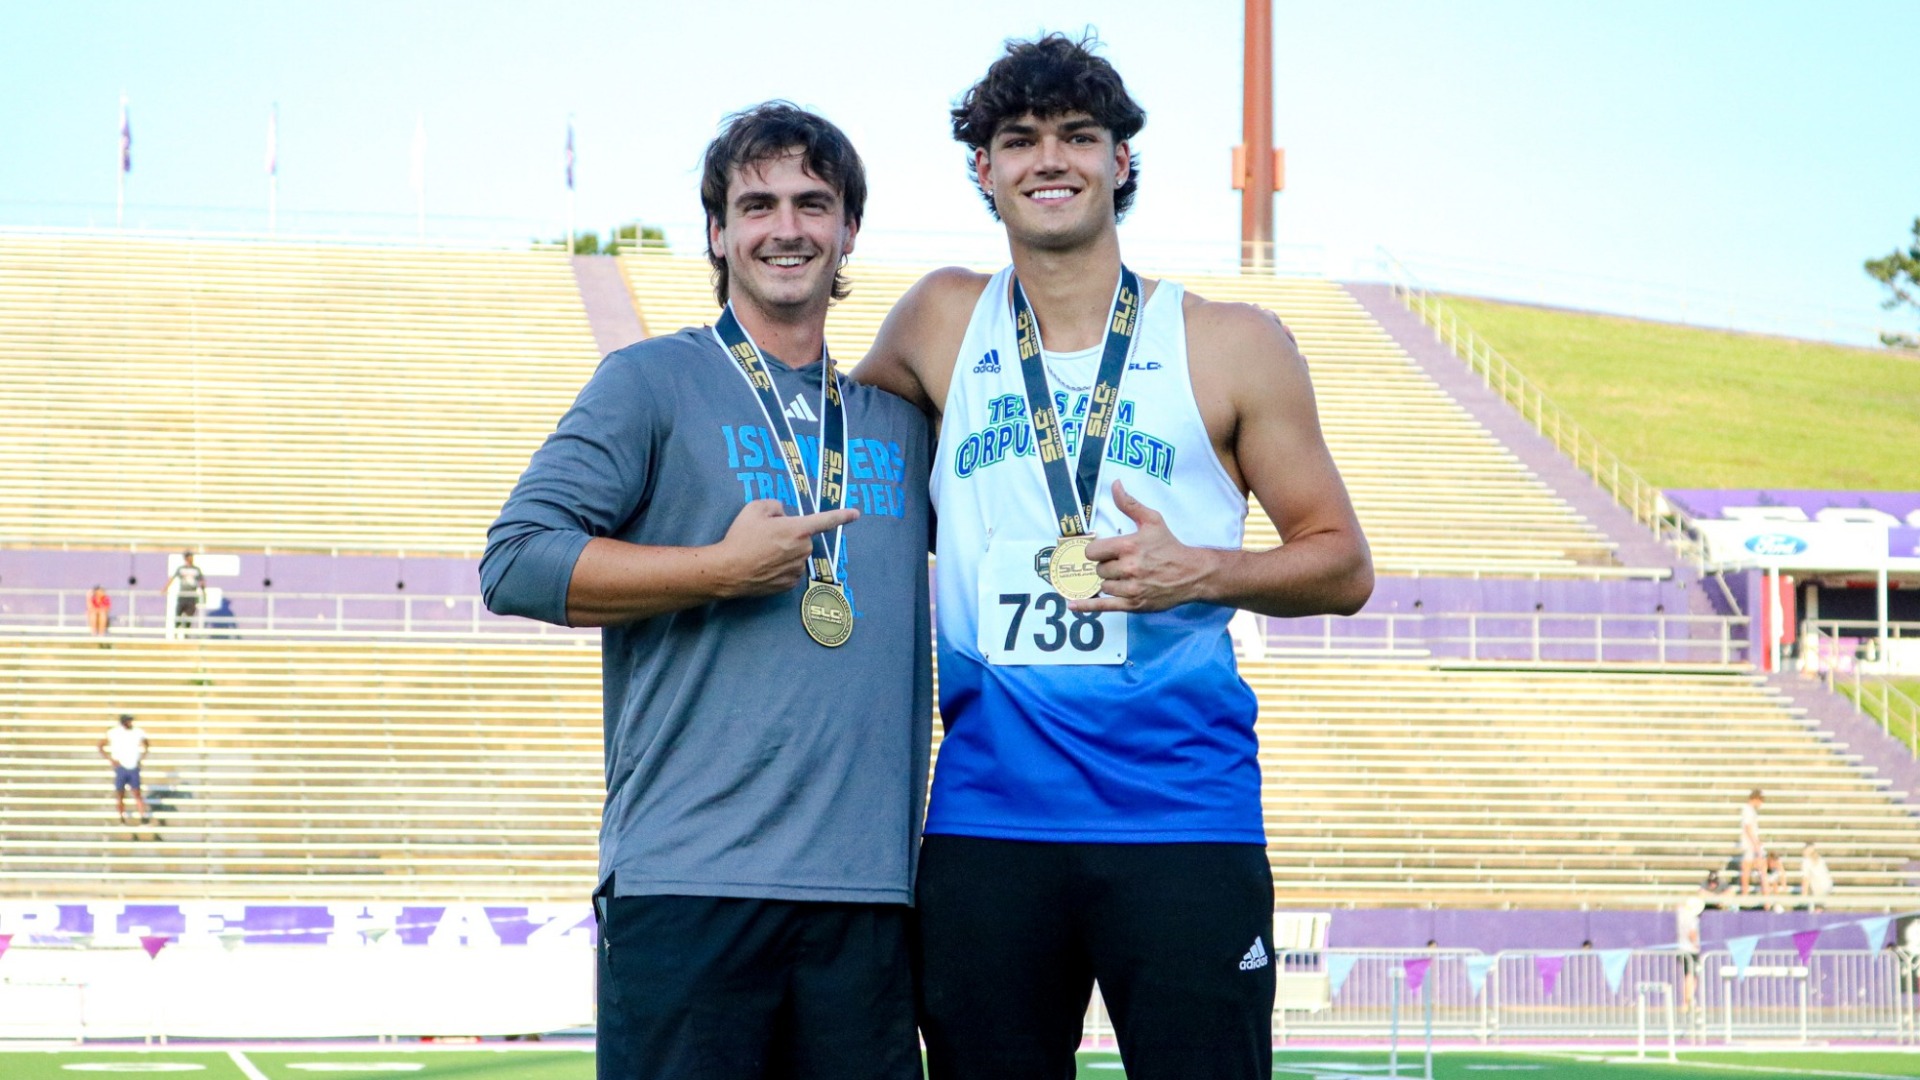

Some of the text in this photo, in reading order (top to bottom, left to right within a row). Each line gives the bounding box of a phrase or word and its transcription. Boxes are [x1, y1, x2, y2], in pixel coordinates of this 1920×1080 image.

[1018, 310, 1034, 361] SLC
[1112, 287, 1134, 336] SLC
[734, 341, 770, 391] SLC
[988, 390, 1135, 426] TEXS AM
[1047, 408, 1064, 459] SOUTHLAND
[1086, 381, 1111, 437] SLC
[1101, 388, 1117, 438] SOUTHLAND
[721, 425, 905, 484] ISLNERS
[955, 418, 1176, 486] CORPU CISTI
[1034, 407, 1058, 463] SLC
[827, 450, 843, 504] SLC
[810, 605, 843, 620] SLC
[999, 592, 1105, 652] 738
[1239, 955, 1269, 971] adidas
